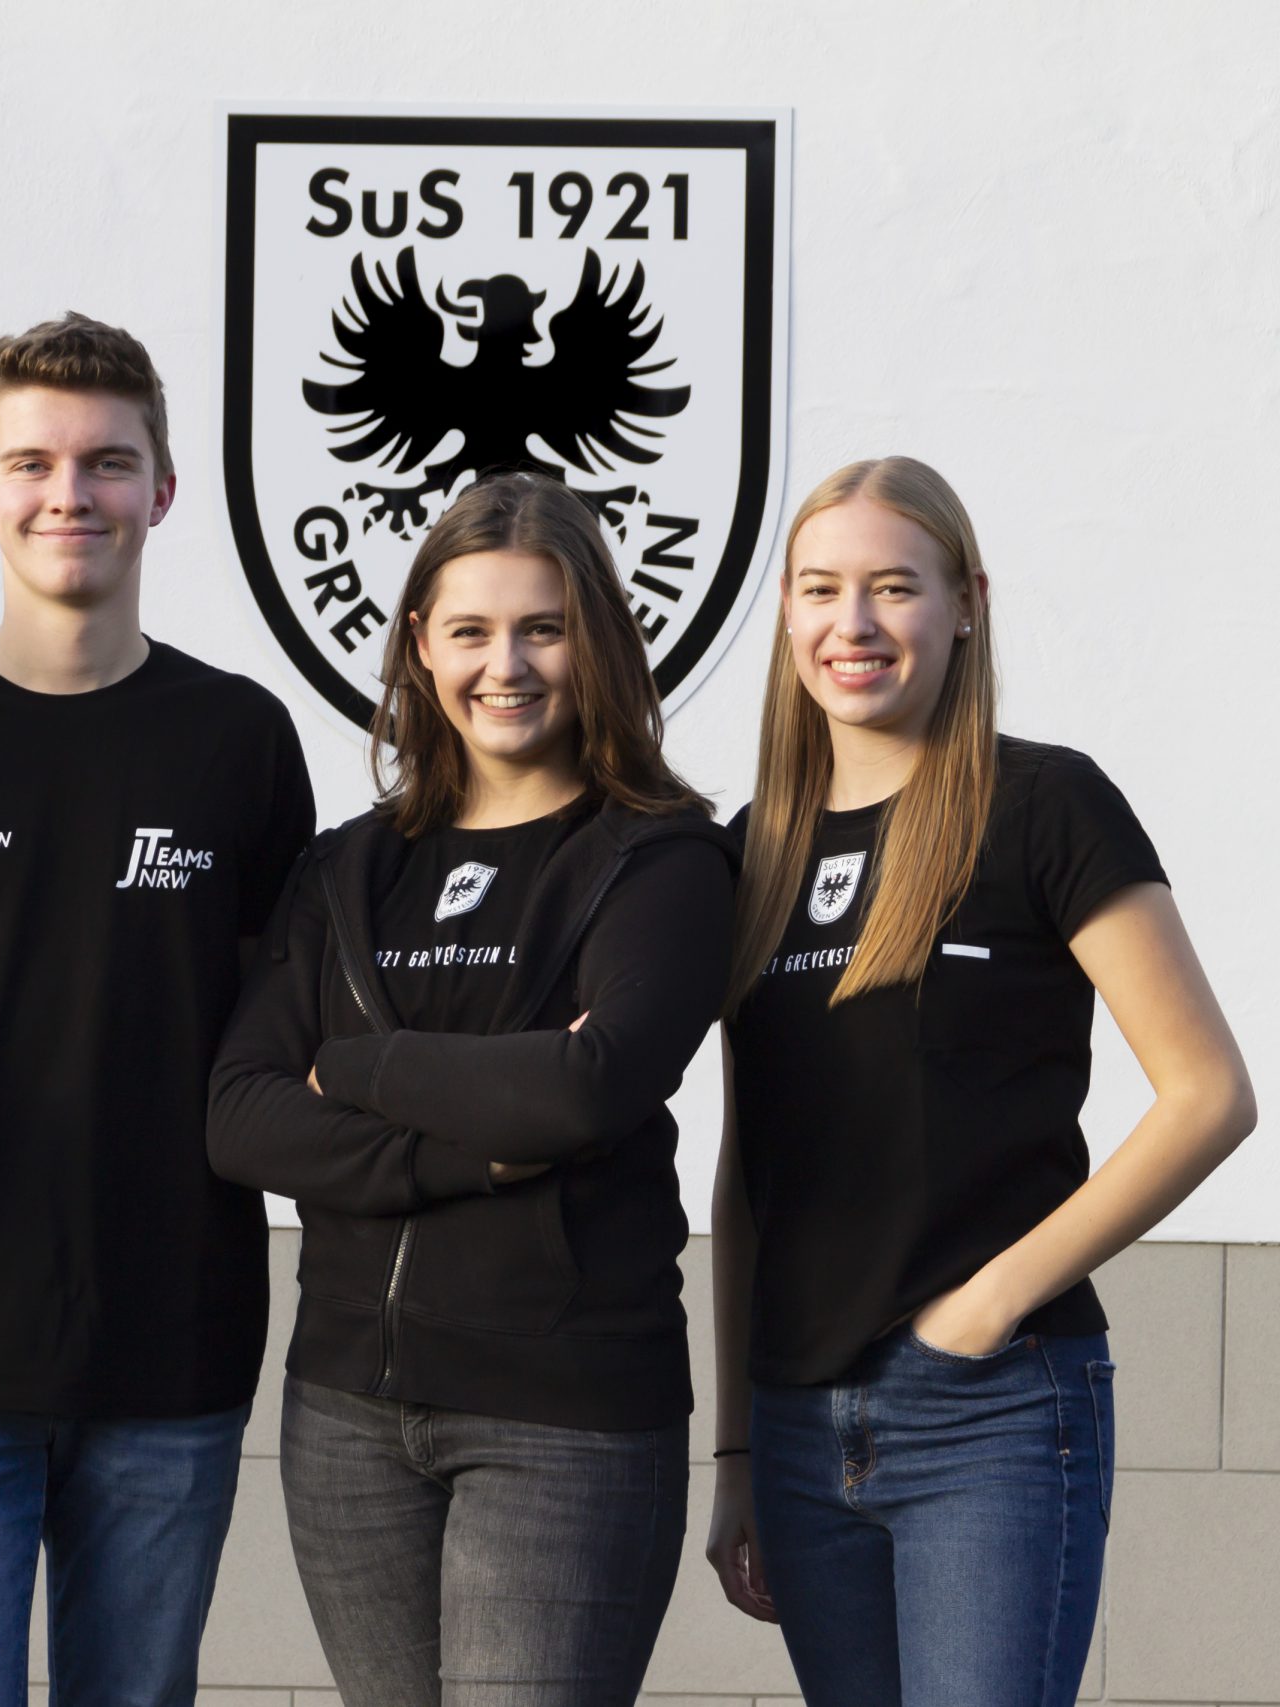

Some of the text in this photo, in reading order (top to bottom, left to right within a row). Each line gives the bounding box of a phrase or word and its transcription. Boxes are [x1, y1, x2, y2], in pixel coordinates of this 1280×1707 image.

[305, 166, 690, 241] SuS 1921
[138, 868, 192, 889] NRW
